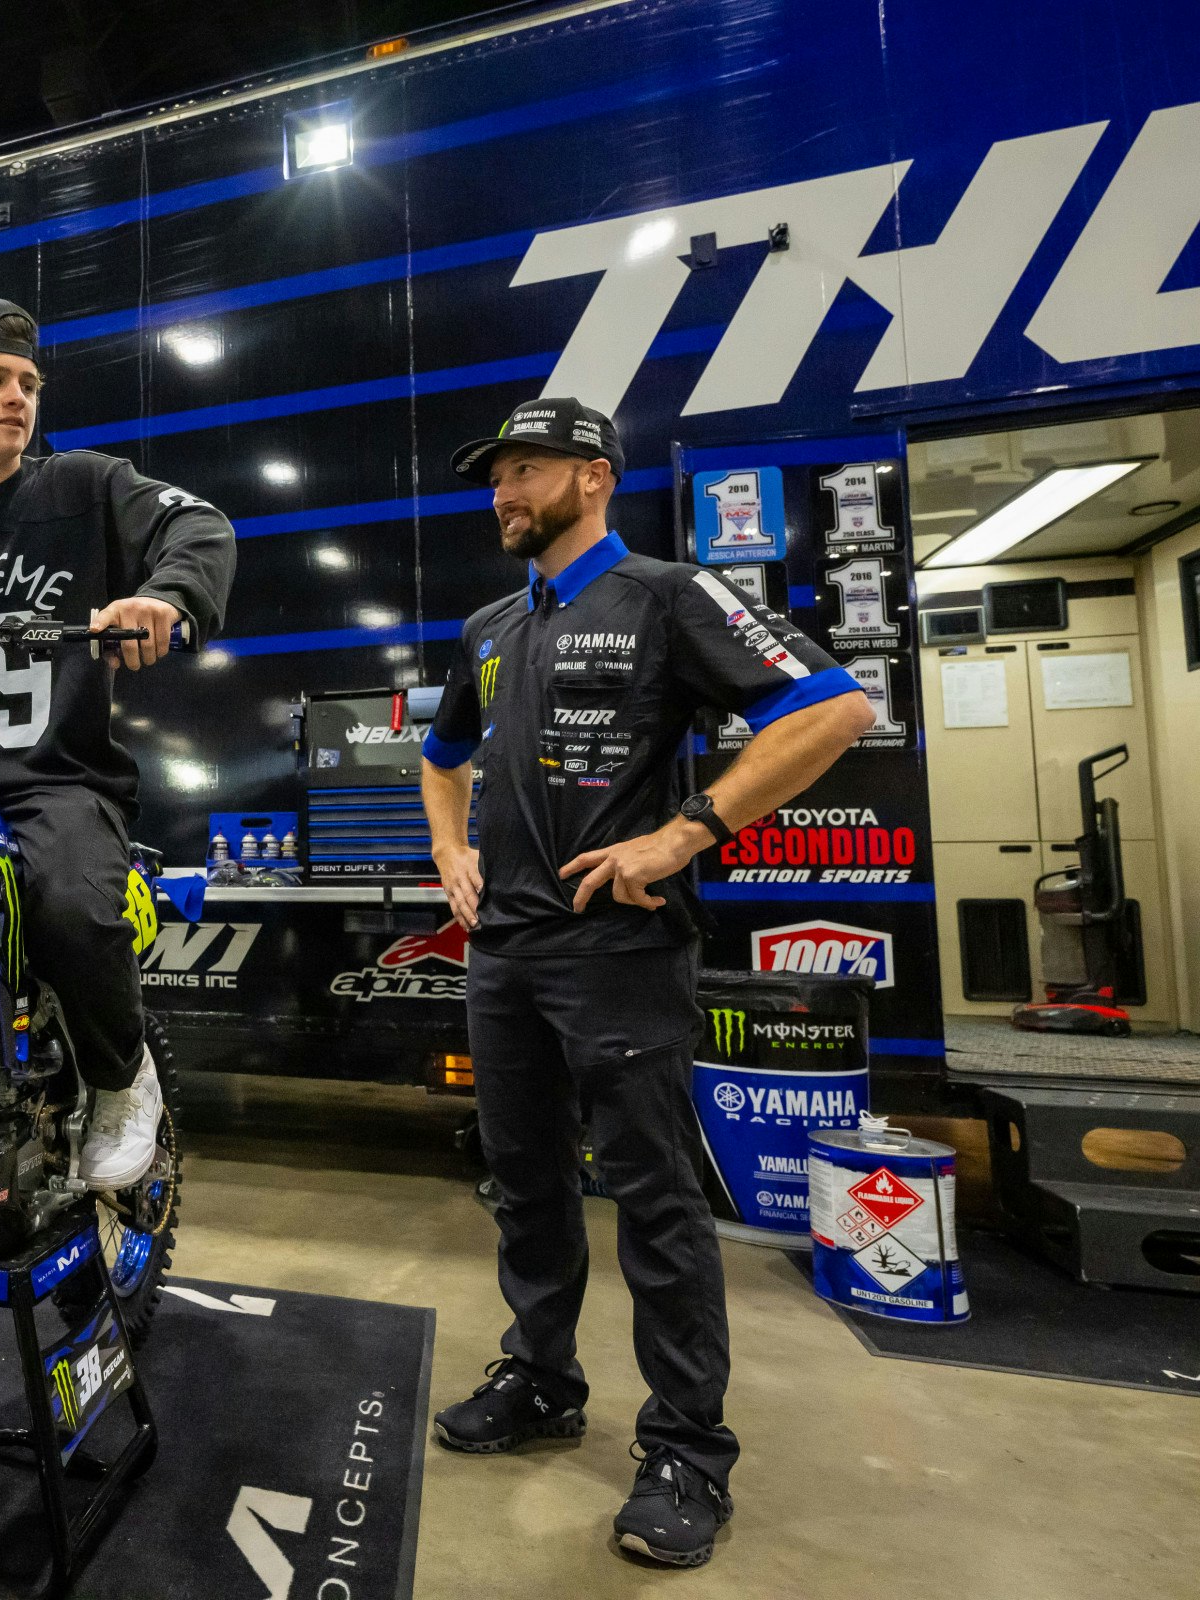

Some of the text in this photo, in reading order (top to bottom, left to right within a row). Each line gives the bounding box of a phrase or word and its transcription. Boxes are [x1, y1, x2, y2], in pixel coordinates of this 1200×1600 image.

[522, 410, 556, 419] YAMAHA
[845, 476, 867, 486] 2014
[728, 485, 749, 494] 2010
[861, 542, 895, 552] MARTIN
[707, 548, 777, 561] JESSICA PATTERSON
[850, 572, 872, 581] 2016
[22, 629, 62, 641] ARC
[574, 633, 636, 649] YAMAHA
[833, 638, 898, 650] COOPER WEBB
[555, 661, 587, 671] YAMALUBE
[604, 662, 633, 670] YAMAHA
[855, 669, 879, 679] 2020
[553, 708, 617, 725] THOR
[579, 731, 632, 739] BICYCLES
[717, 741, 743, 749] AARON
[861, 738, 906, 747] FERRANDIS
[778, 808, 879, 826] TOYOTA
[720, 826, 916, 865] ESCONDIDO
[344, 864, 375, 872] DUFFE
[728, 868, 912, 884] ACTION SPORTS
[769, 939, 878, 978] 100%
[205, 975, 237, 989] INC
[753, 1023, 855, 1040] MONSTER
[771, 1041, 845, 1050] ENERGY
[746, 1086, 857, 1117] YAMAHA
[726, 1112, 852, 1128] RACING
[757, 1155, 809, 1174] YAMALU
[773, 1194, 810, 1208] YAMA
[759, 1209, 798, 1220] FINANCIAL
[856, 1289, 928, 1308] UN1203 GASOLINE
[103, 1349, 125, 1381] DEEGAN
[76, 1343, 103, 1407] 38
[316, 1398, 384, 1600] ONCEPTS
